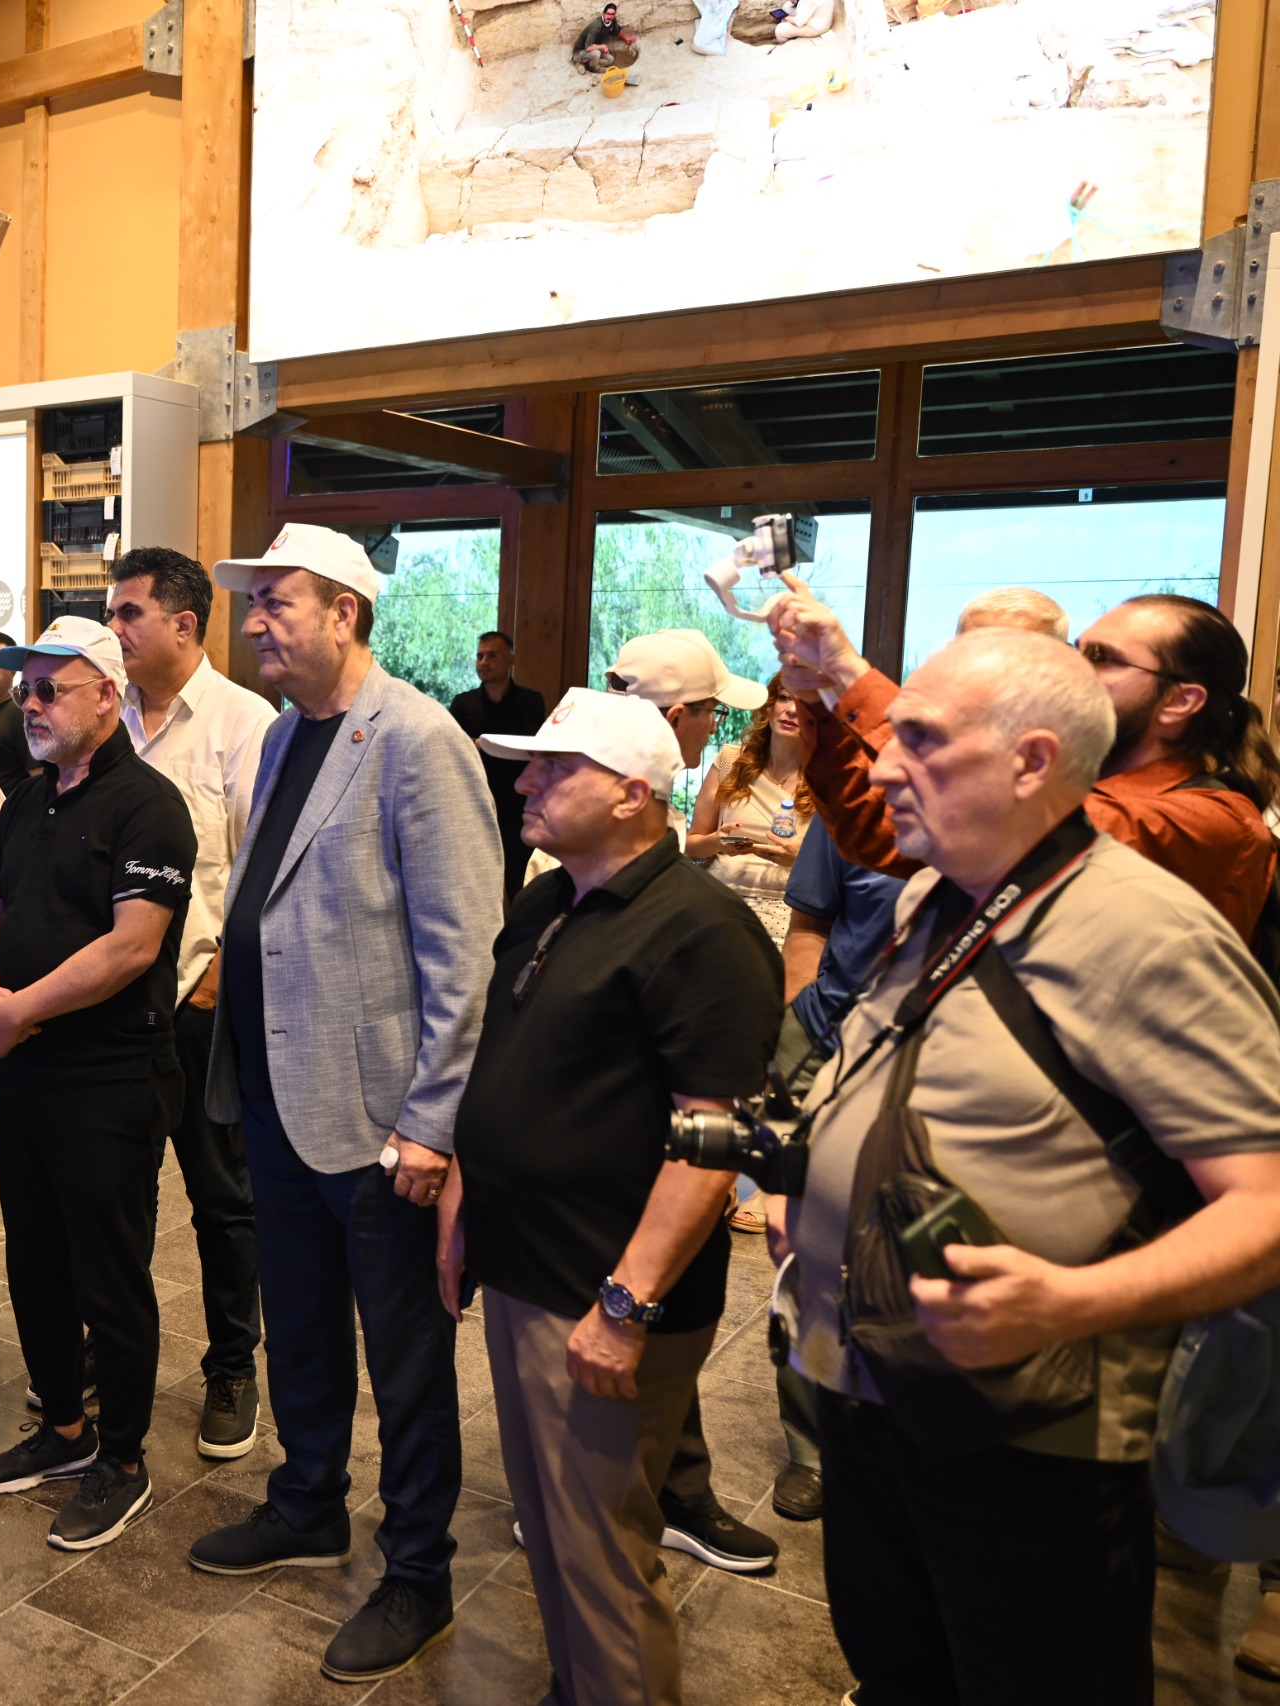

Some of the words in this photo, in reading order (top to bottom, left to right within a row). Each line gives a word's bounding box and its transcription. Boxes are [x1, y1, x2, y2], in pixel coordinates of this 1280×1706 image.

[125, 860, 160, 880] Tommy
[984, 883, 1022, 920] EOS
[929, 919, 987, 981] DIGITAL
